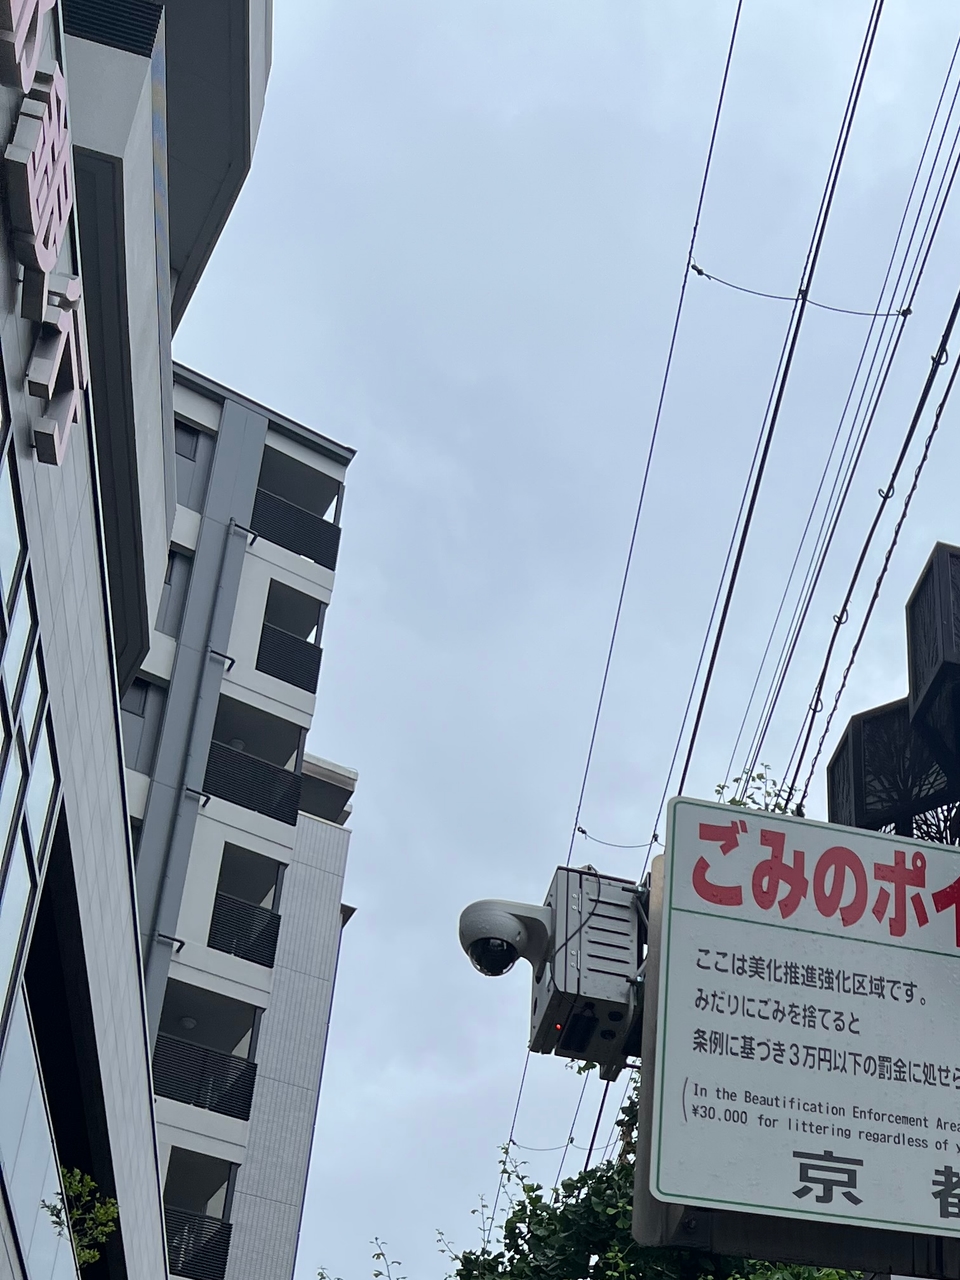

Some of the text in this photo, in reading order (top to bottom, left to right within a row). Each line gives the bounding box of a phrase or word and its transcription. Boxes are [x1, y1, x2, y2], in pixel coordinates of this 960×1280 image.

[696, 948, 927, 1006] ここは美化推進強化区域です。
[694, 988, 861, 1035] みだりにごみを捨てると
[716, 1087, 737, 1101] the
[744, 1090, 846, 1117] Beautification
[852, 1106, 929, 1129] Enforcement
[757, 1114, 779, 1128] for
[788, 1118, 851, 1139] littering
[858, 1129, 928, 1149] regardless
[935, 1139, 949, 1151] of
